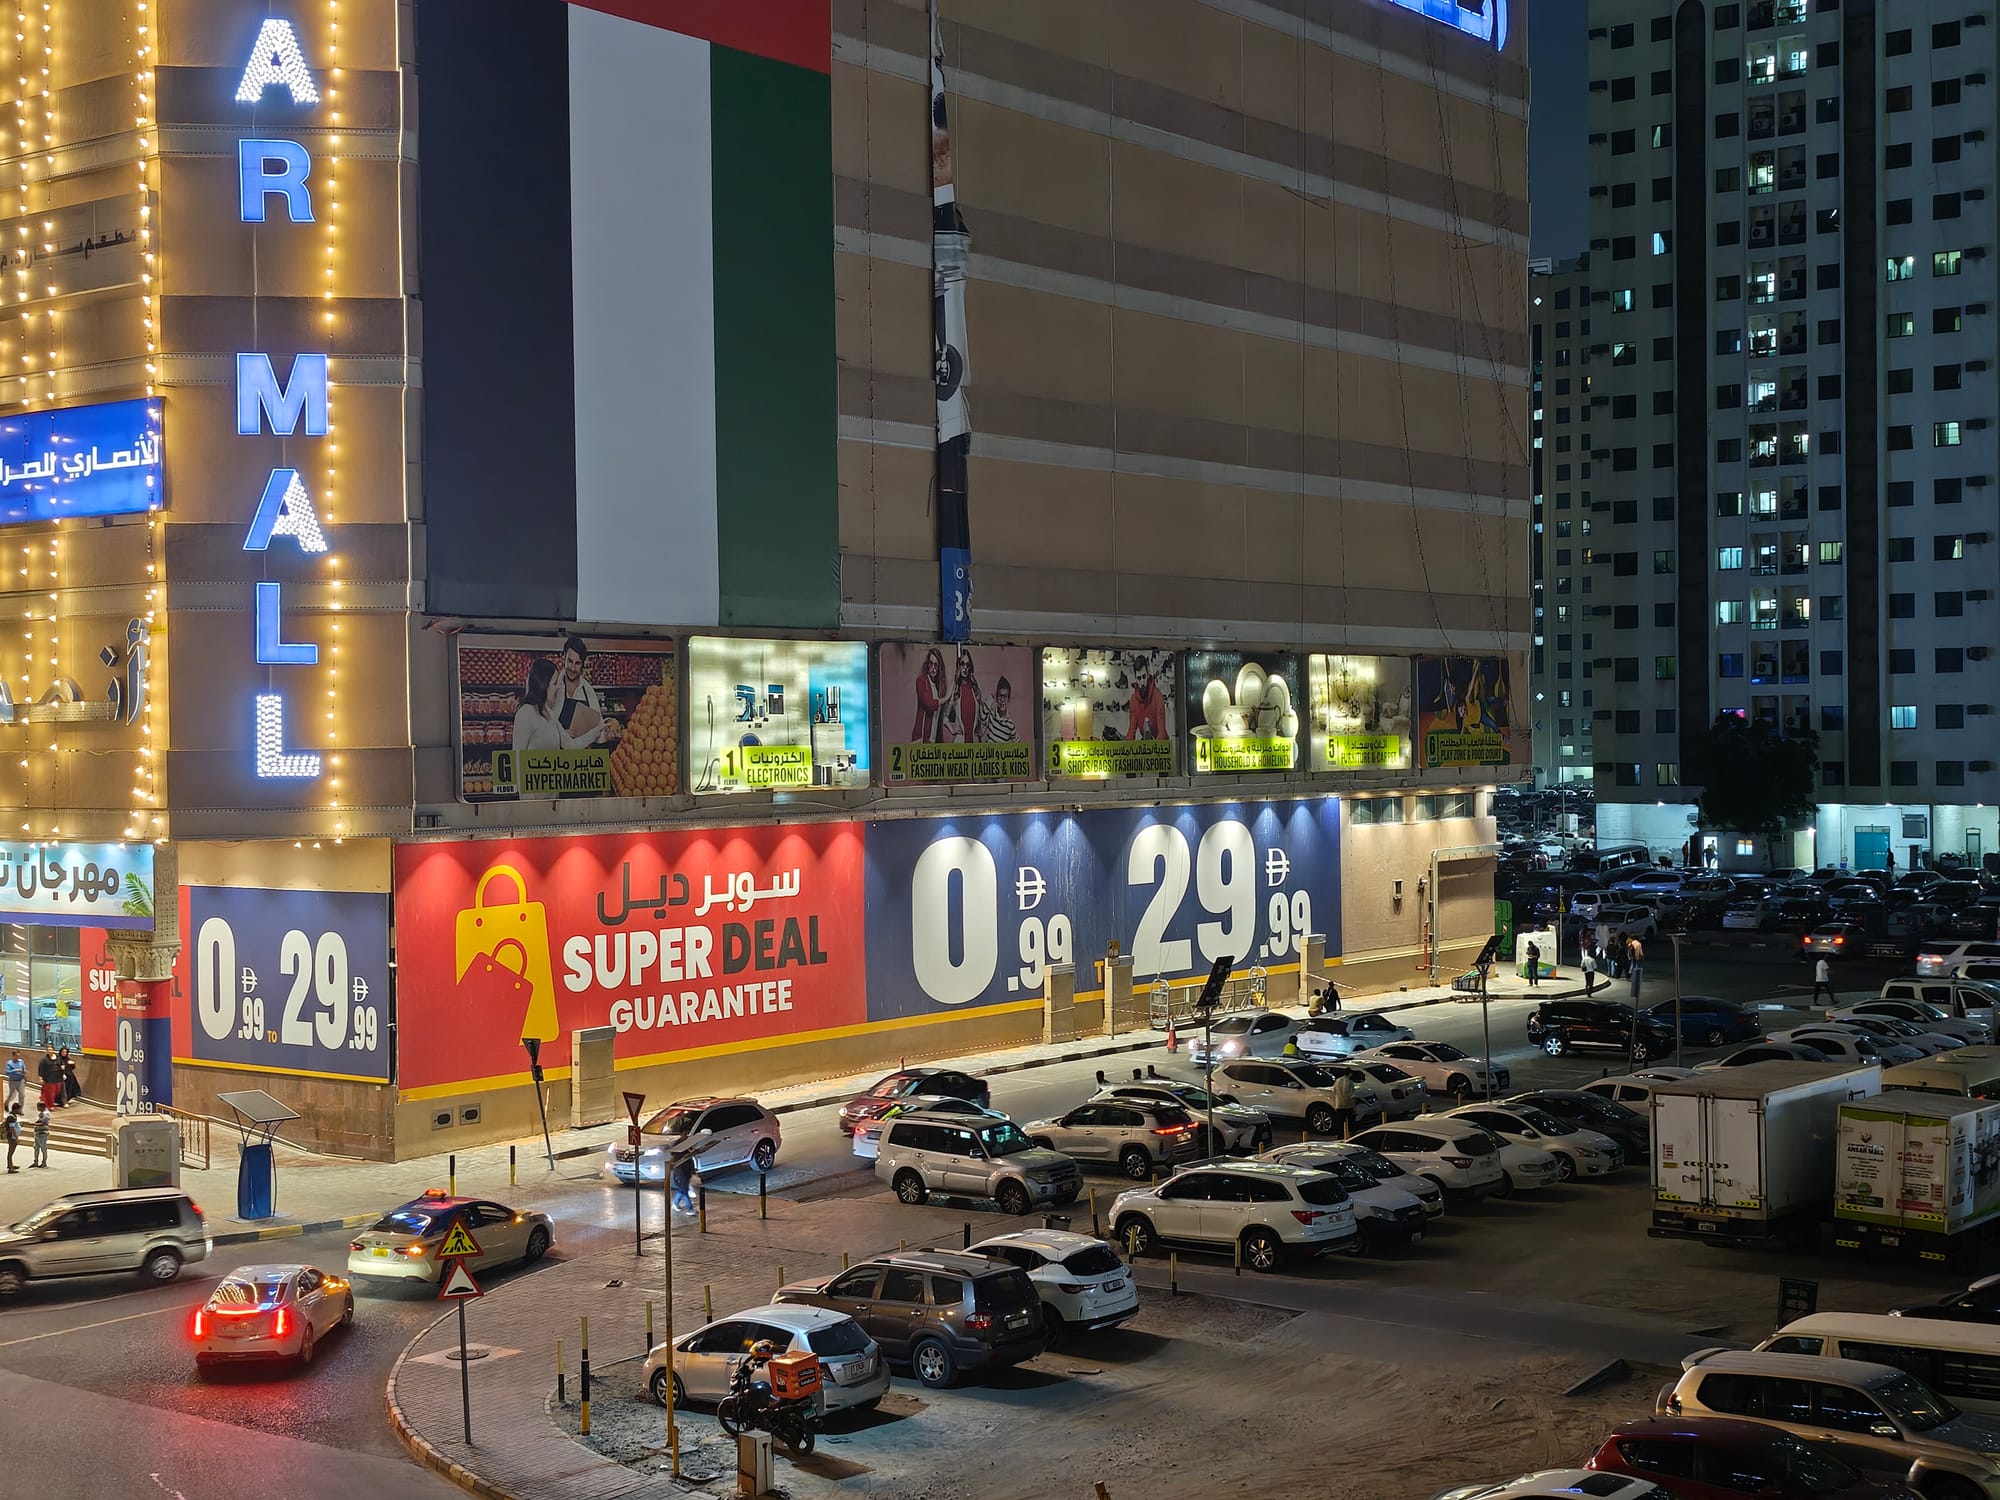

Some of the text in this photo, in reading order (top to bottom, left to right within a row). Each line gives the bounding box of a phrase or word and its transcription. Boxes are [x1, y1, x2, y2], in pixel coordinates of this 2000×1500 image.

[62, 433, 160, 479] الأنصاري
[235, 351, 330, 778] MALL
[1053, 744, 1060, 766] 3
[1200, 741, 1207, 762] 4
[1328, 739, 1335, 759] 5
[1429, 736, 1436, 756] 6
[498, 753, 512, 782] G
[527, 756, 604, 772] هايبر ماركت
[726, 750, 735, 776] 1
[892, 746, 901, 771] 2
[911, 761, 1030, 778] FASHION WEAR (LADIES & KIDS)
[1214, 755, 1251, 768] HOUSEHOLD
[1252, 755, 1257, 768] &
[525, 771, 608, 791] HYPERMARKET
[746, 767, 809, 784] ELECTRONICS
[16, 847, 120, 903] مهرجان
[597, 861, 800, 926] سوبر ديل
[563, 914, 828, 993] SUPER DEAL
[609, 978, 793, 1034] GUARANTEE
[266, 1029, 278, 1044] TO
